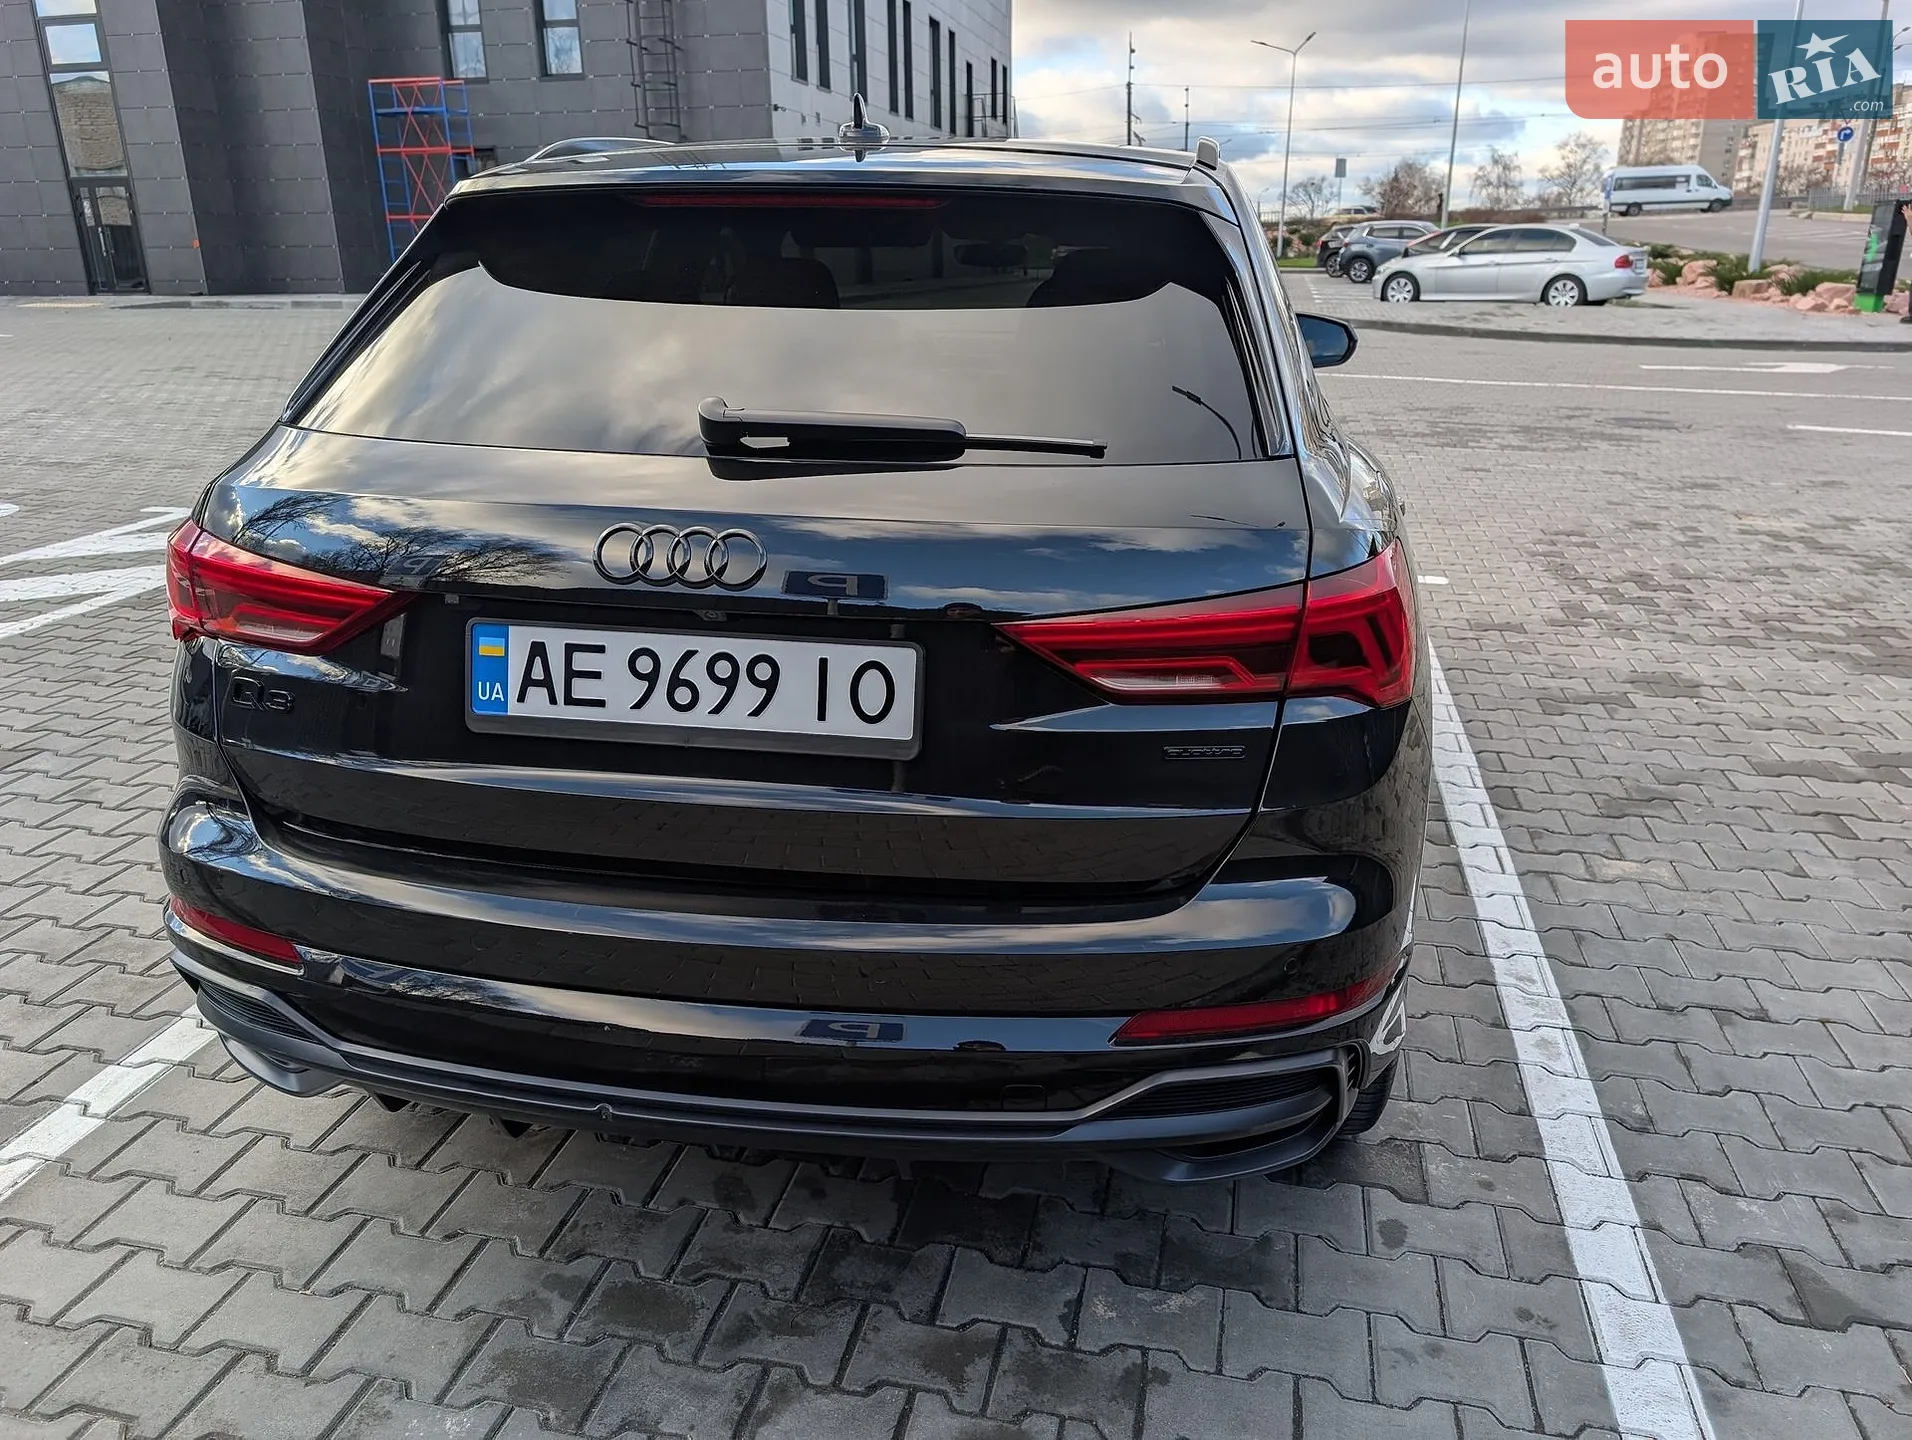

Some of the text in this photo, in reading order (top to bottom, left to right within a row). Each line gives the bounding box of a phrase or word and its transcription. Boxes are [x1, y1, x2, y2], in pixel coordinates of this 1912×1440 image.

[478, 681, 505, 702] UA
[516, 640, 896, 725] AE 9699 IO
